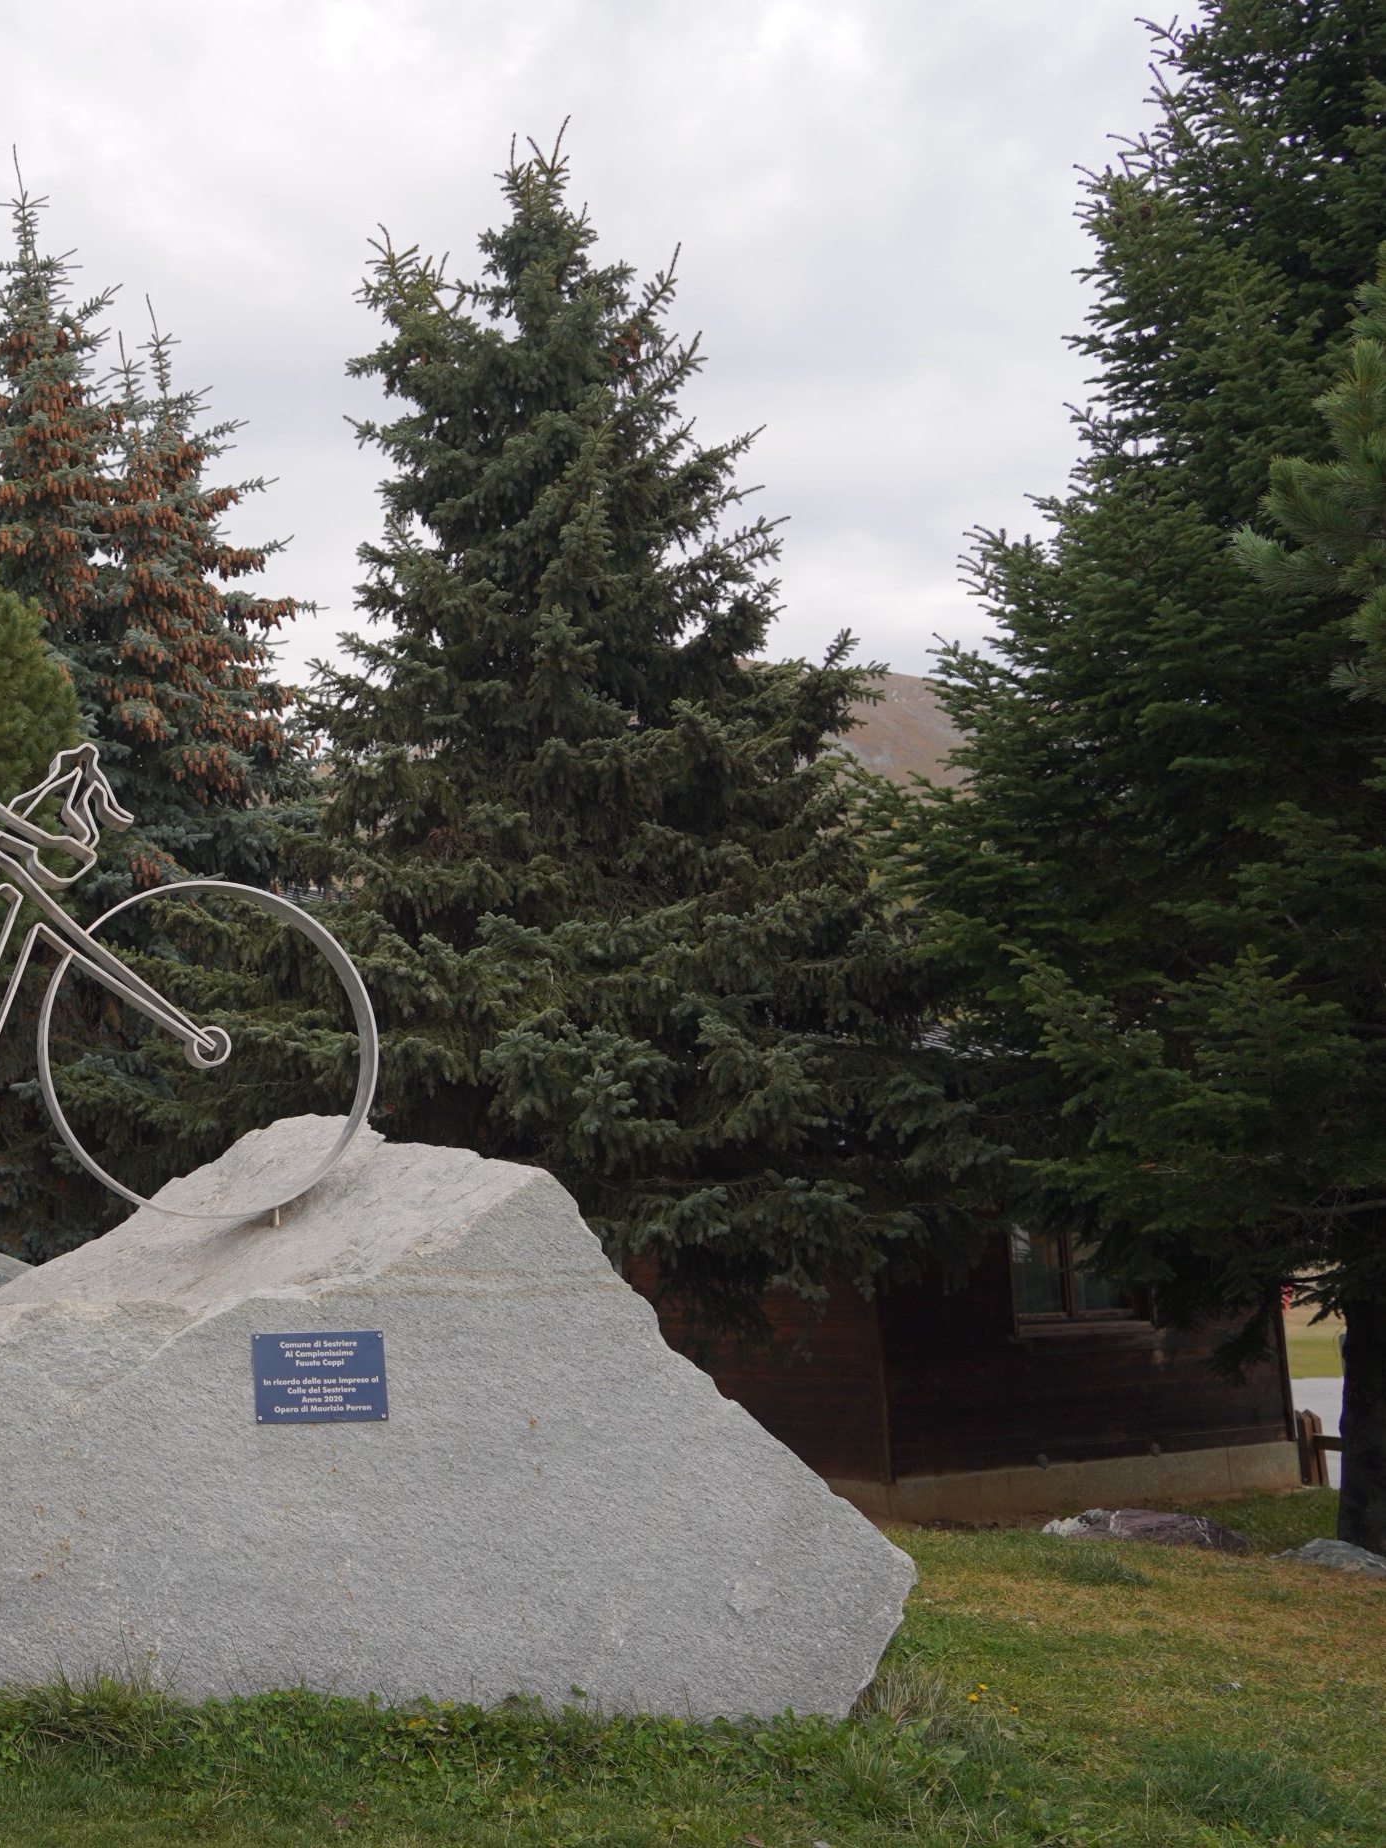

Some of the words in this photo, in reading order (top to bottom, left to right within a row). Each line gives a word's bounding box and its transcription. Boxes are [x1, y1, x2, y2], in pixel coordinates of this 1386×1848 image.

[280, 1341, 311, 1349] Comune
[295, 1350, 354, 1358] Campionissimo
[323, 1359, 344, 1367] Coppi
[287, 1387, 307, 1395] Colle
[274, 1406, 298, 1414] Opera
[301, 1405, 308, 1413] di
